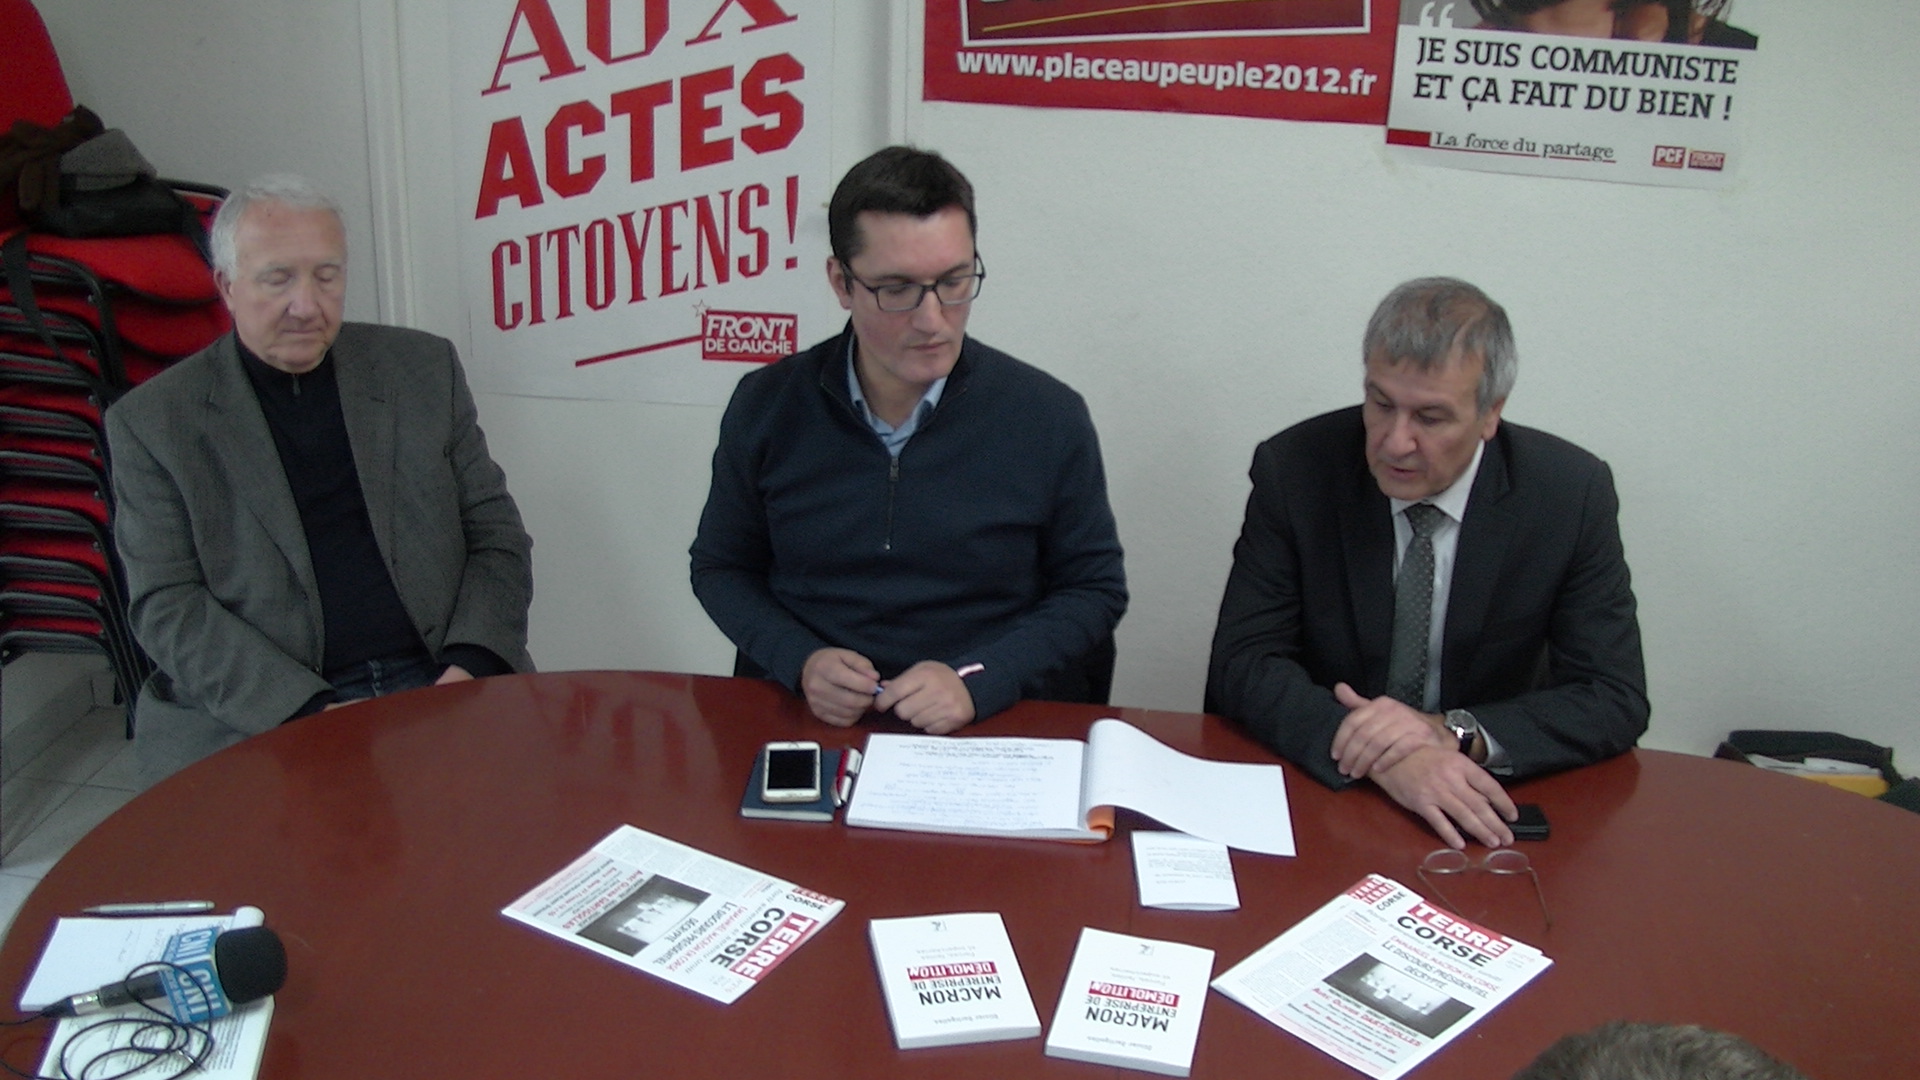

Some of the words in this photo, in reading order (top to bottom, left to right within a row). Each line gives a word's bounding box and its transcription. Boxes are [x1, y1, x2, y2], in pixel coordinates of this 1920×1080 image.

[1417, 37, 1445, 65] JE
[1454, 39, 1521, 68] SUIS
[1530, 45, 1739, 84] COMMUNISTE
[956, 51, 1378, 96] www.placeaupeuple2012.fr
[1413, 73, 1453, 100] ET
[1462, 76, 1501, 112] ÇA
[1509, 79, 1577, 109] FAIT
[1584, 85, 1631, 112] DU
[1636, 89, 1714, 120] BIEN
[475, 52, 804, 220] ACTES
[1434, 131, 1459, 147] La
[1464, 132, 1509, 152] force
[1513, 137, 1536, 153] du
[1542, 141, 1614, 163] partage
[1655, 147, 1684, 164] PCF
[706, 314, 794, 340] FRONT
[705, 337, 726, 352] DE
[728, 338, 793, 355] GAUCHE
[784, 893, 827, 911] CORSE
[1374, 890, 1407, 911] CORSE
[707, 905, 791, 968] CORSE
[1392, 914, 1494, 968] CORSE
[1408, 903, 1510, 956] TERRE
[732, 915, 816, 978] TERRE
[1379, 939, 1398, 951] LE
[909, 961, 993, 978] DÉMOLITION
[179, 969, 222, 1014] CNI
[912, 980, 927, 991] DE
[933, 975, 1002, 990] ENTREPRISE
[1090, 981, 1175, 1005] DÉMOLITION
[918, 986, 1002, 1006] MACRON
[1084, 994, 1102, 1006] DE
[1104, 997, 1177, 1018] ENTREPRISE
[1085, 1006, 1169, 1032] MACRON
